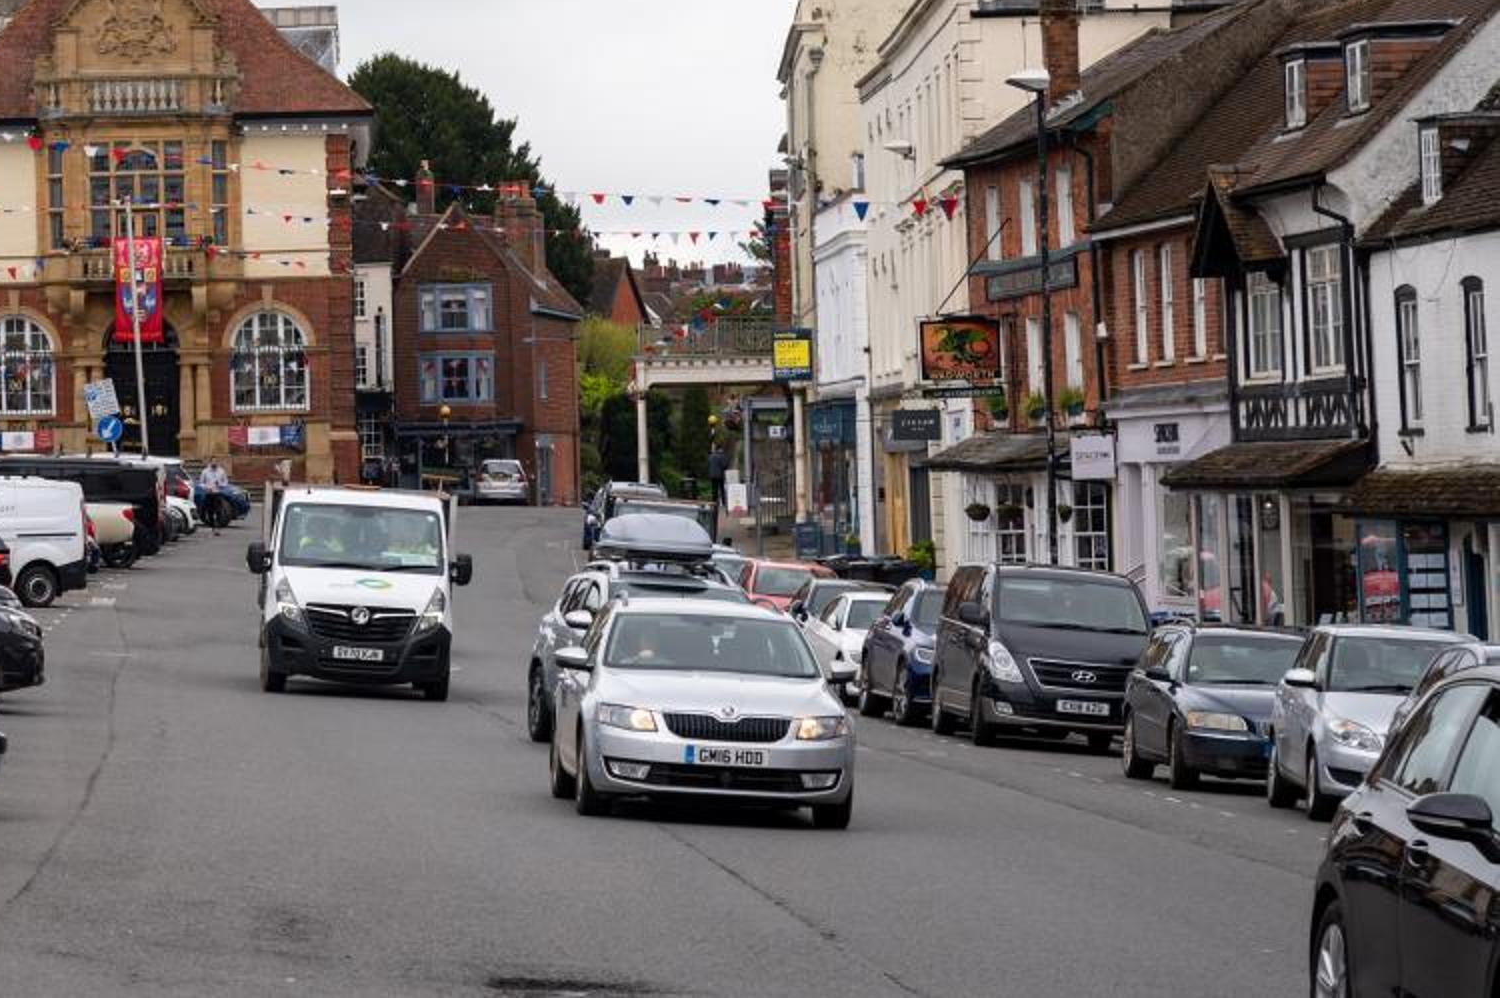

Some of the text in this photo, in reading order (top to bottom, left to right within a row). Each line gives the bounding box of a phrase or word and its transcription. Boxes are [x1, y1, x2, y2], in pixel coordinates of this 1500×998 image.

[929, 368, 996, 380] WADWORTH
[699, 748, 763, 765] GM16 HDD
